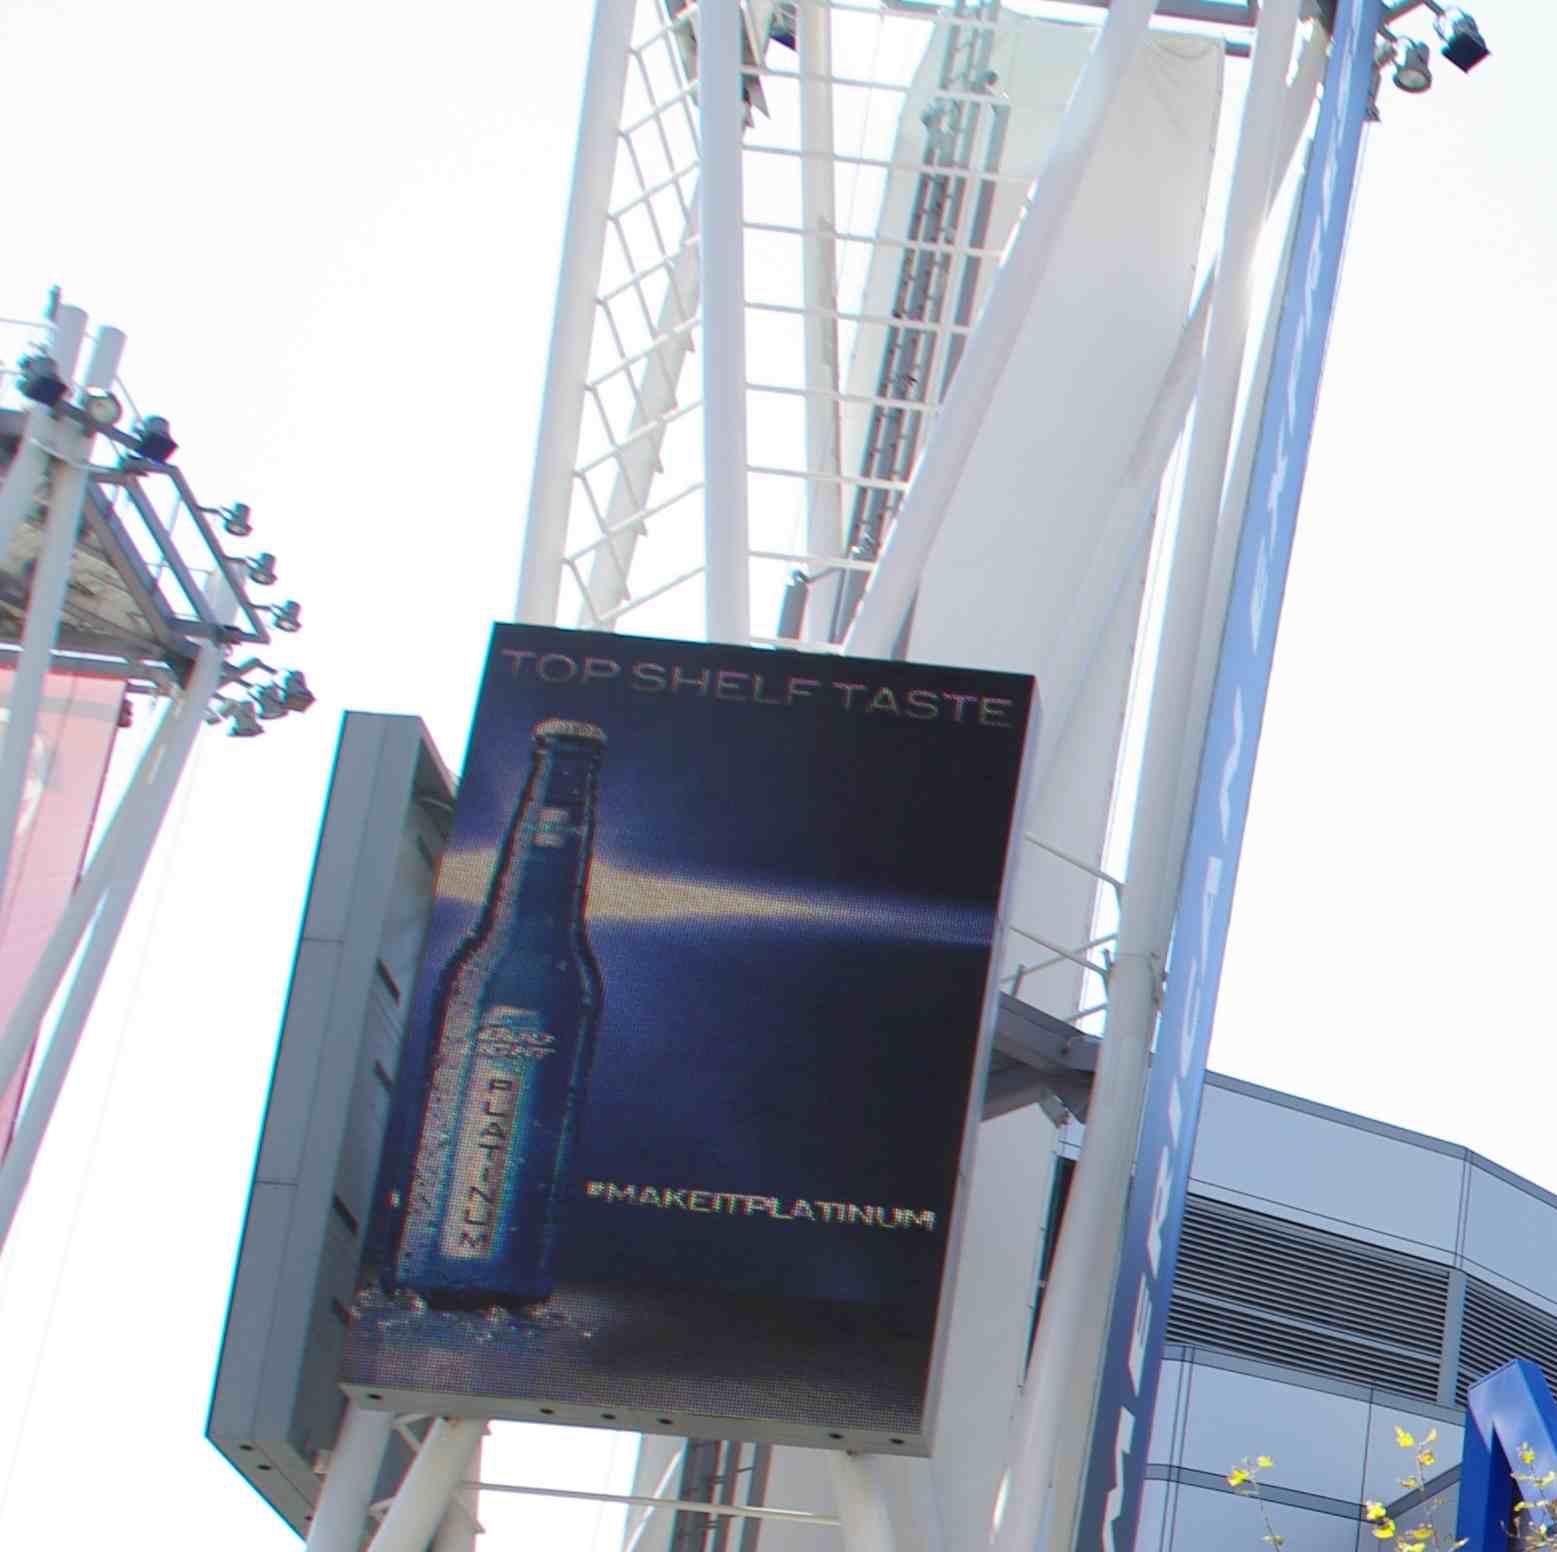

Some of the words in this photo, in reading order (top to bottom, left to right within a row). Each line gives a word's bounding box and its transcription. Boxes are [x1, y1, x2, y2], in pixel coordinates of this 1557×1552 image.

[499, 647, 621, 685] TOP
[631, 661, 822, 707] SHELF
[831, 681, 1014, 730] TASTE
[585, 1179, 936, 1234] #MAKEITPLATINUM
